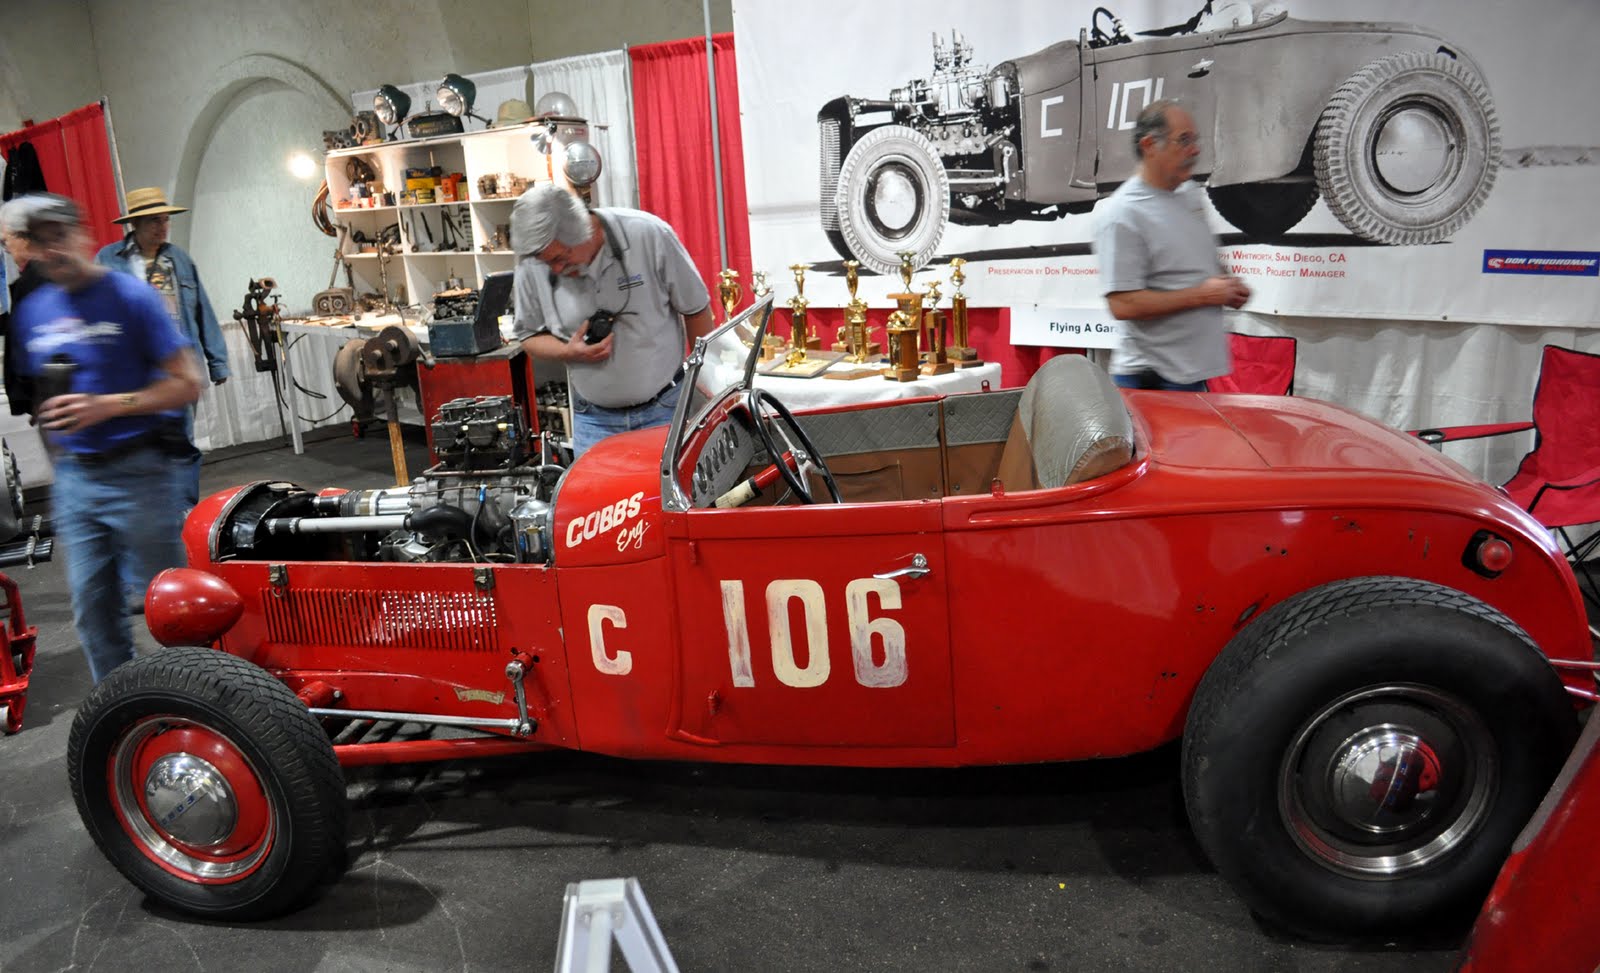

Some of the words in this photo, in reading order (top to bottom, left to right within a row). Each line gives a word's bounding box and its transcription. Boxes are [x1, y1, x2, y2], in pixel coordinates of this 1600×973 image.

[1040, 95, 1064, 138] C
[1266, 266, 1296, 277] PROJECT
[1299, 268, 1345, 278] MANAGER
[1275, 252, 1291, 262] SAN
[1293, 253, 1325, 264] DIEGO,
[1328, 253, 1346, 263] CA
[1050, 322, 1081, 334] Flying
[1084, 323, 1092, 333] A
[566, 491, 644, 549] COBBS
[616, 518, 651, 553] Eng.
[587, 603, 633, 676] C
[719, 577, 909, 688] 106
